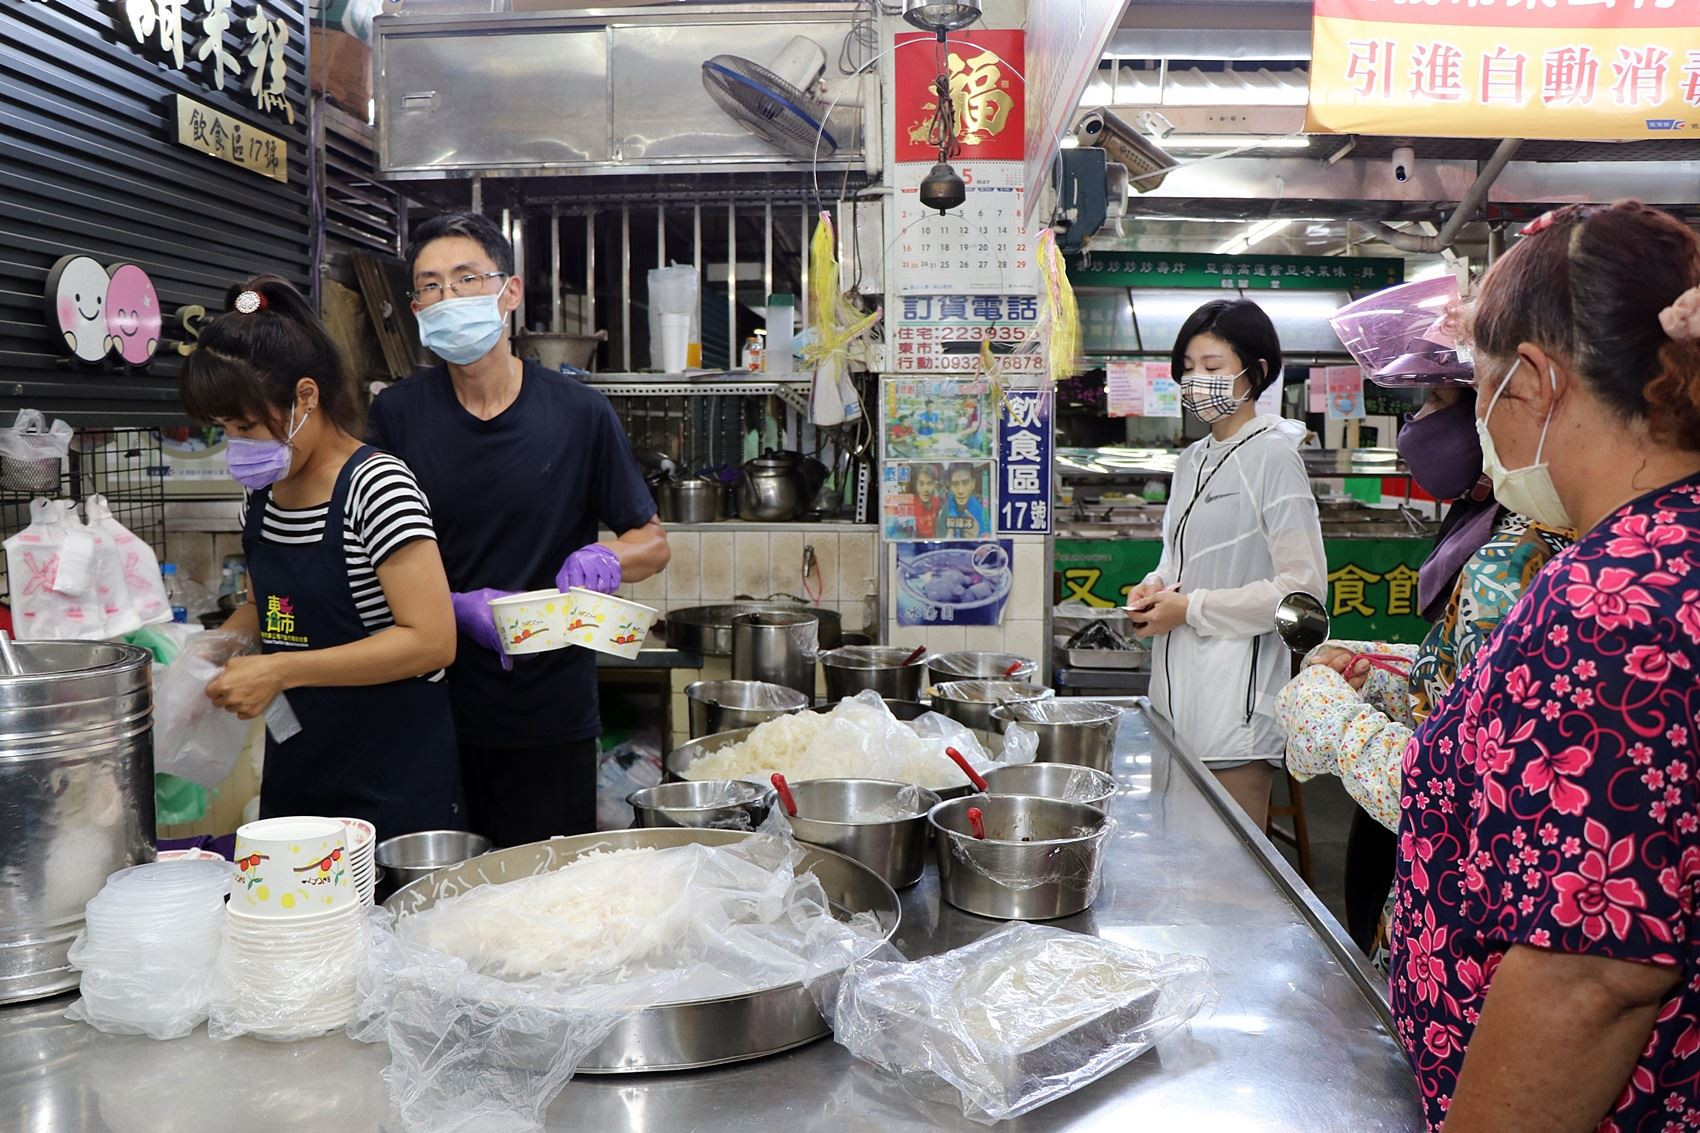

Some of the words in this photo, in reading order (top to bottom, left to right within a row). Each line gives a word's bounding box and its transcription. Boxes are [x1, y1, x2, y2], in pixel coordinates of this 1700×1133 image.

[928, 51, 1015, 137] 福
[189, 107, 280, 176] 飲食區17號
[963, 168, 973, 185] 5
[903, 296, 1038, 321] 訂貨電話
[898, 356, 1043, 369] 行動:093276878
[1007, 396, 1042, 494] 飲食區
[1001, 500, 1047, 530] 17號
